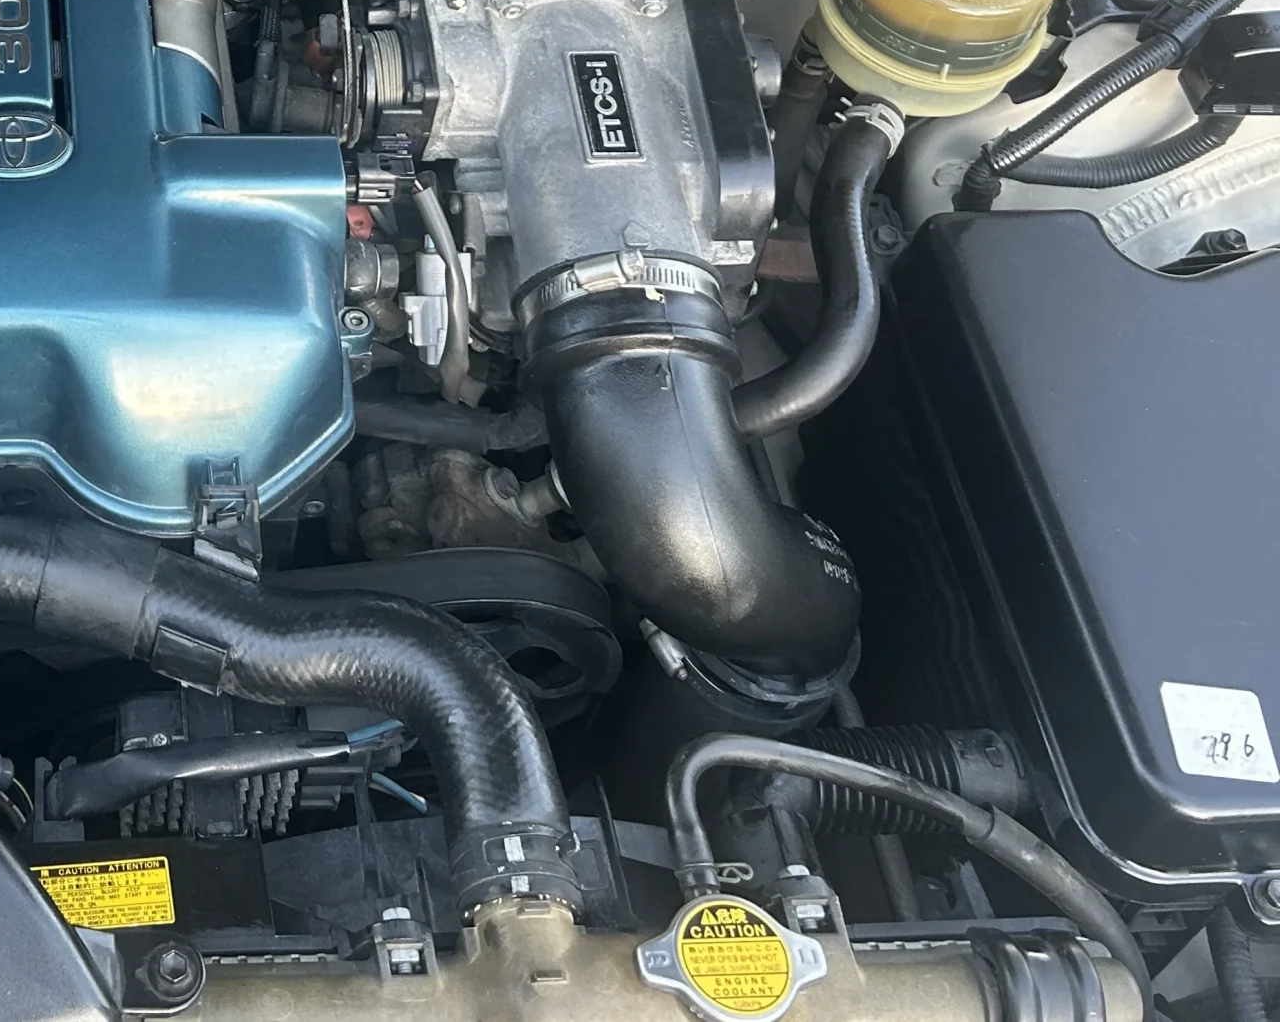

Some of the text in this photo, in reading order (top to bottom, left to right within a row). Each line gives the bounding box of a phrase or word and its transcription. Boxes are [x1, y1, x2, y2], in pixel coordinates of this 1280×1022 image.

[58, 866, 100, 876] CAUTION
[108, 860, 160, 872] ATTENTION
[716, 908, 749, 924] 危険
[689, 923, 767, 939] CAUTION
[690, 953, 777, 965] NEVER OPEN WHEN HOT
[715, 976, 769, 986] ENGINE
[713, 986, 775, 996] COOLANT
